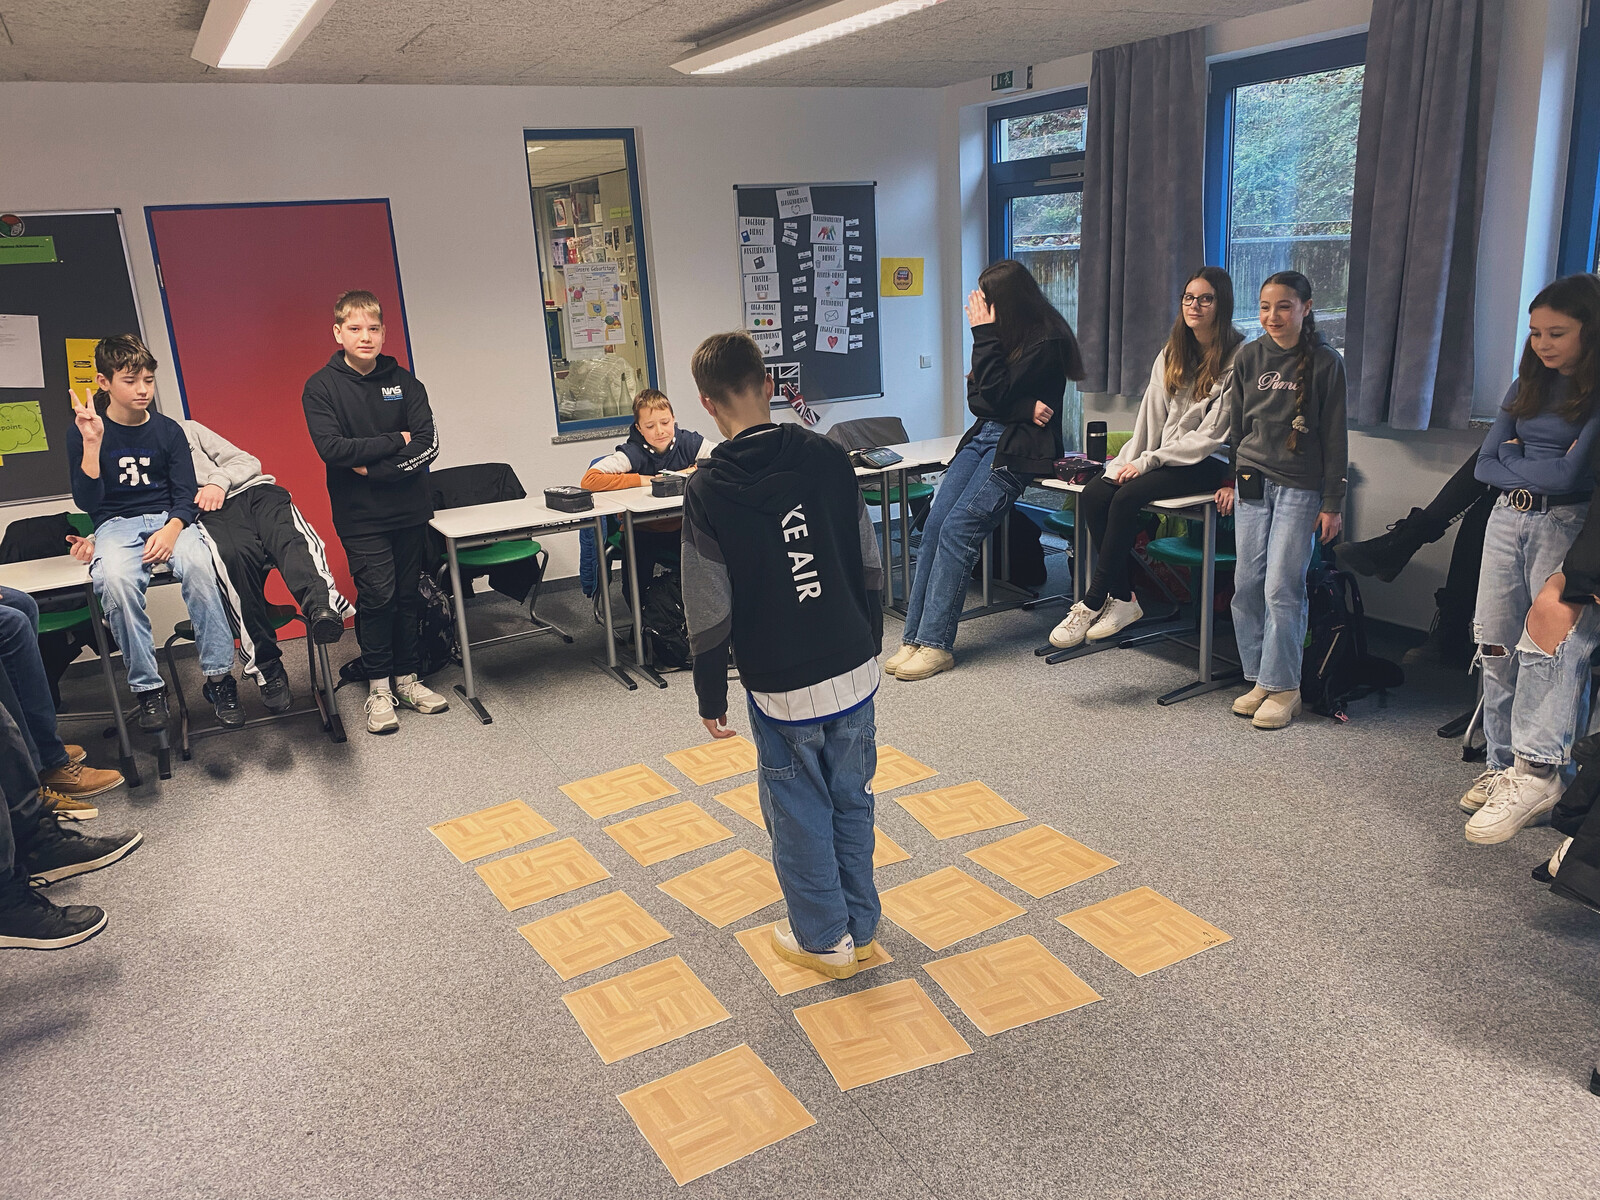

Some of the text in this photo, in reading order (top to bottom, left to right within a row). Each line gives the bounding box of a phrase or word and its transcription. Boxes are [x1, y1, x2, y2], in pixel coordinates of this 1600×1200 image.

[397, 447, 435, 469] THE NATIONAL
[787, 551, 822, 603] AIR
